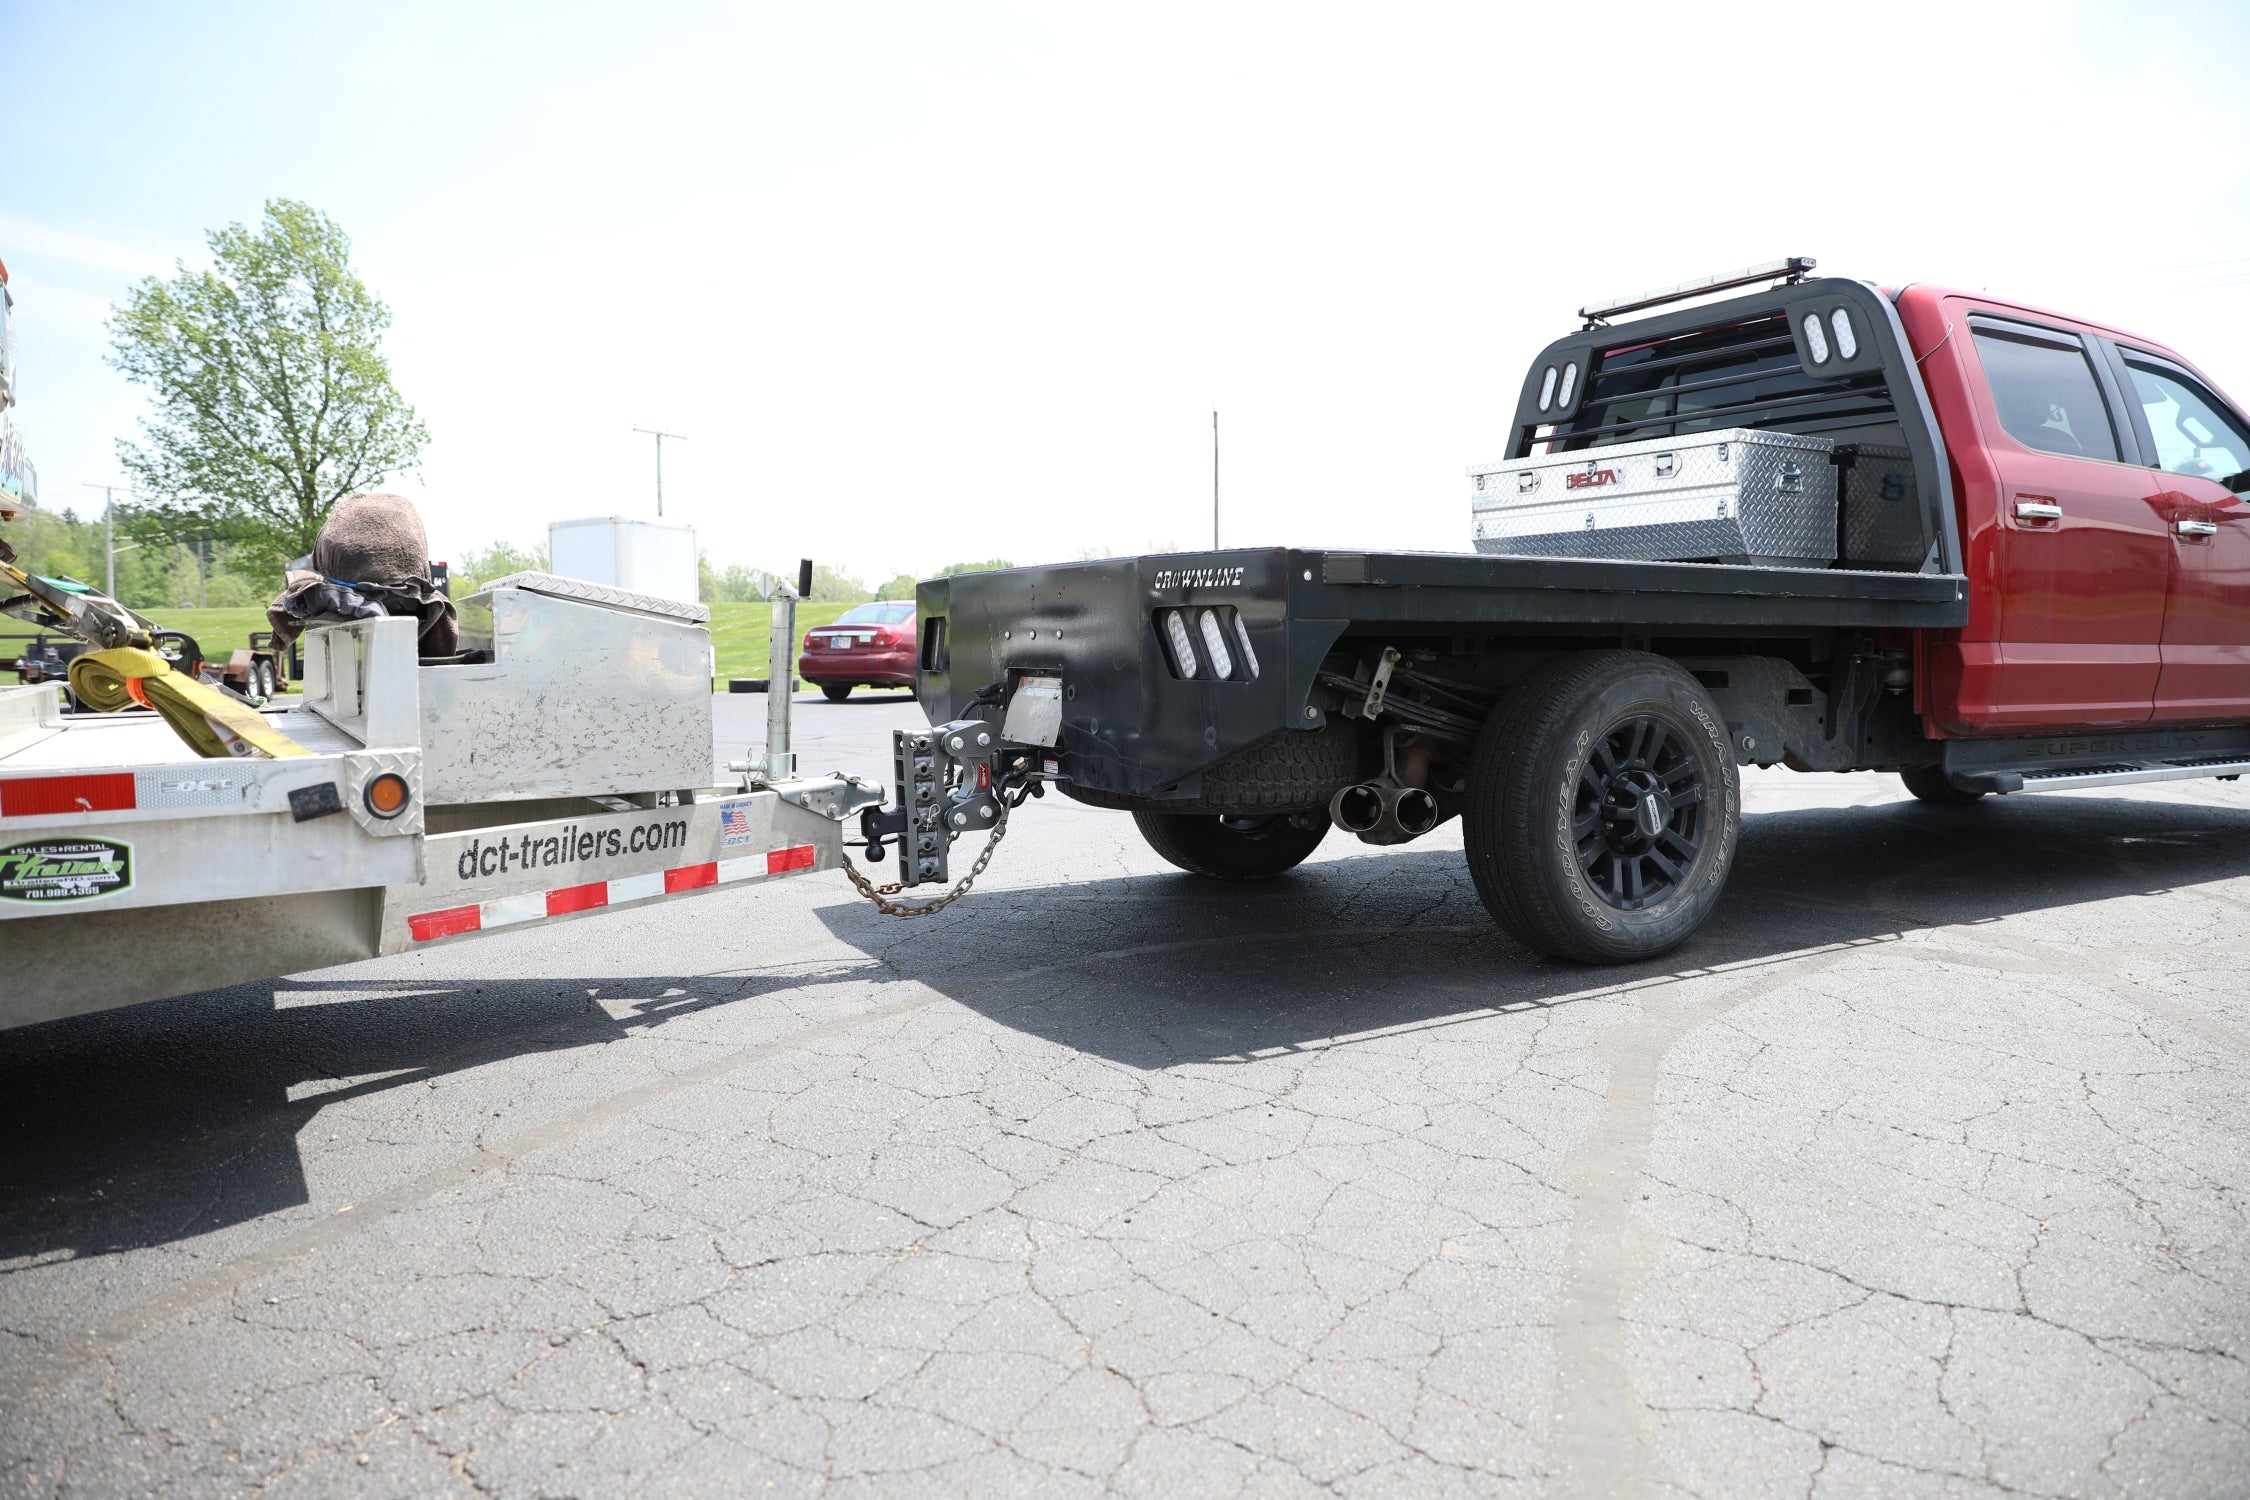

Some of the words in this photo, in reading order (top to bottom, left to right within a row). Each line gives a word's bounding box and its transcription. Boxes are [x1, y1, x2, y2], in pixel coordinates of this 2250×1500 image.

[1154, 566, 1244, 589] CROWNLINE
[2026, 740, 2128, 757] SUPER
[2135, 735, 2206, 750] DUTY
[1689, 700, 1734, 887] WRANGLER
[16, 845, 57, 855] SALES
[64, 843, 110, 852] RENTAL
[458, 819, 687, 880] dct-trailers.com
[1557, 729, 1613, 932] GOODYEAR
